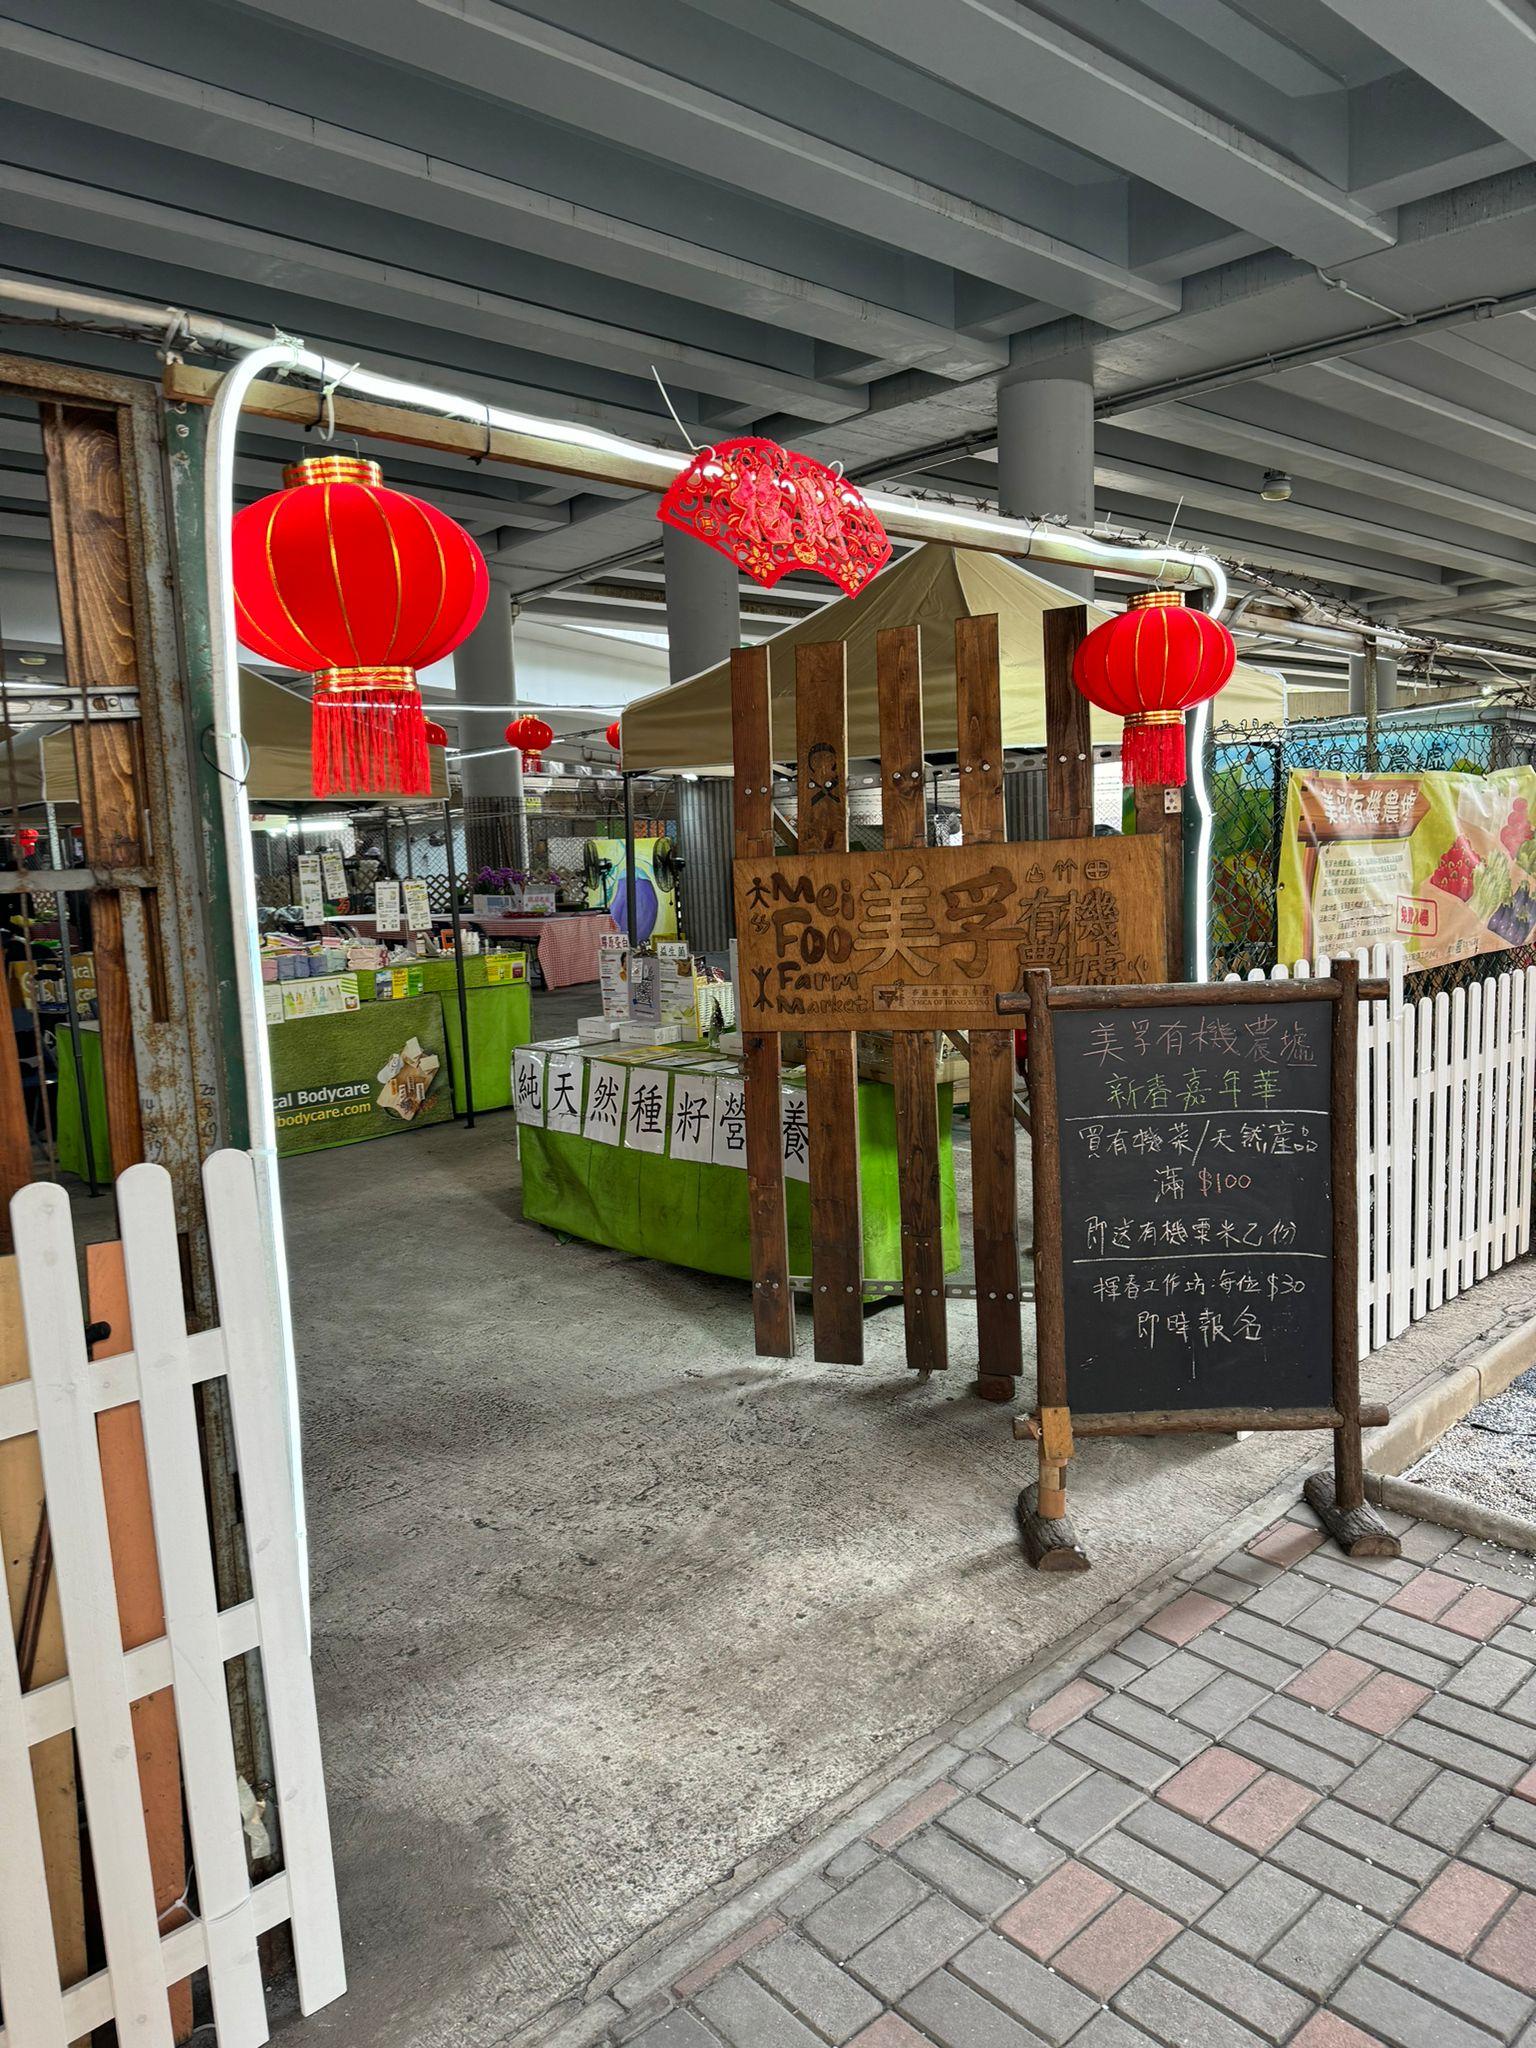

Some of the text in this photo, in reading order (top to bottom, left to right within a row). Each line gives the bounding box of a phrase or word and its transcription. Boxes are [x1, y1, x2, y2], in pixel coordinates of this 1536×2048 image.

[771, 872, 855, 920] Mei
[1016, 886, 1119, 949] 有機
[771, 906, 853, 964] Foo
[854, 864, 1027, 978] 美孚
[777, 961, 859, 991] Farm
[776, 995, 869, 1014] Market
[297, 1083, 370, 1105] Bodycare
[1104, 1068, 1283, 1112] 新春嘉年華
[1154, 1165, 1252, 1203] 滿 $100
[1136, 1304, 1263, 1349] 即時報名
